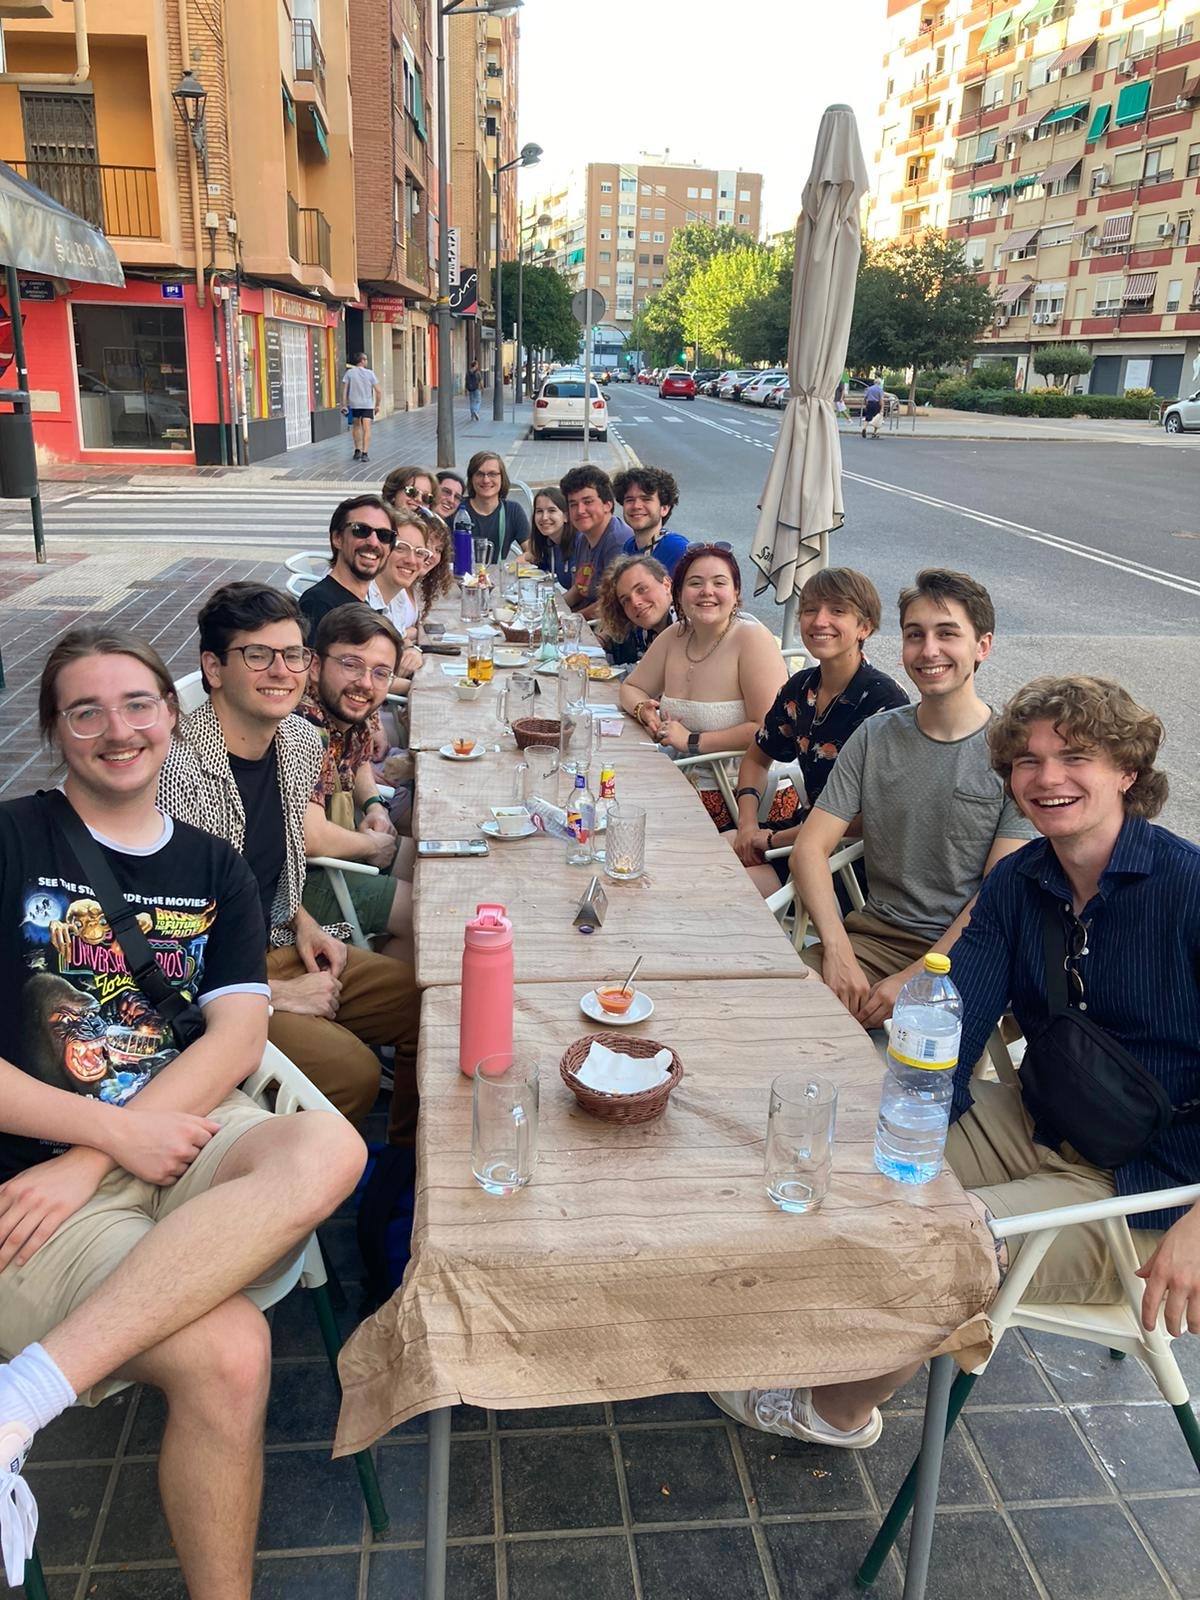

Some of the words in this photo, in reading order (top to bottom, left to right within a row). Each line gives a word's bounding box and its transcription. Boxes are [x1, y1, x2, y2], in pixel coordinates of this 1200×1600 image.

[38, 876, 59, 888] SEE
[59, 877, 77, 893] THE
[78, 884, 96, 897] STA
[142, 896, 164, 905] THE
[164, 919, 202, 932] FUTURE
